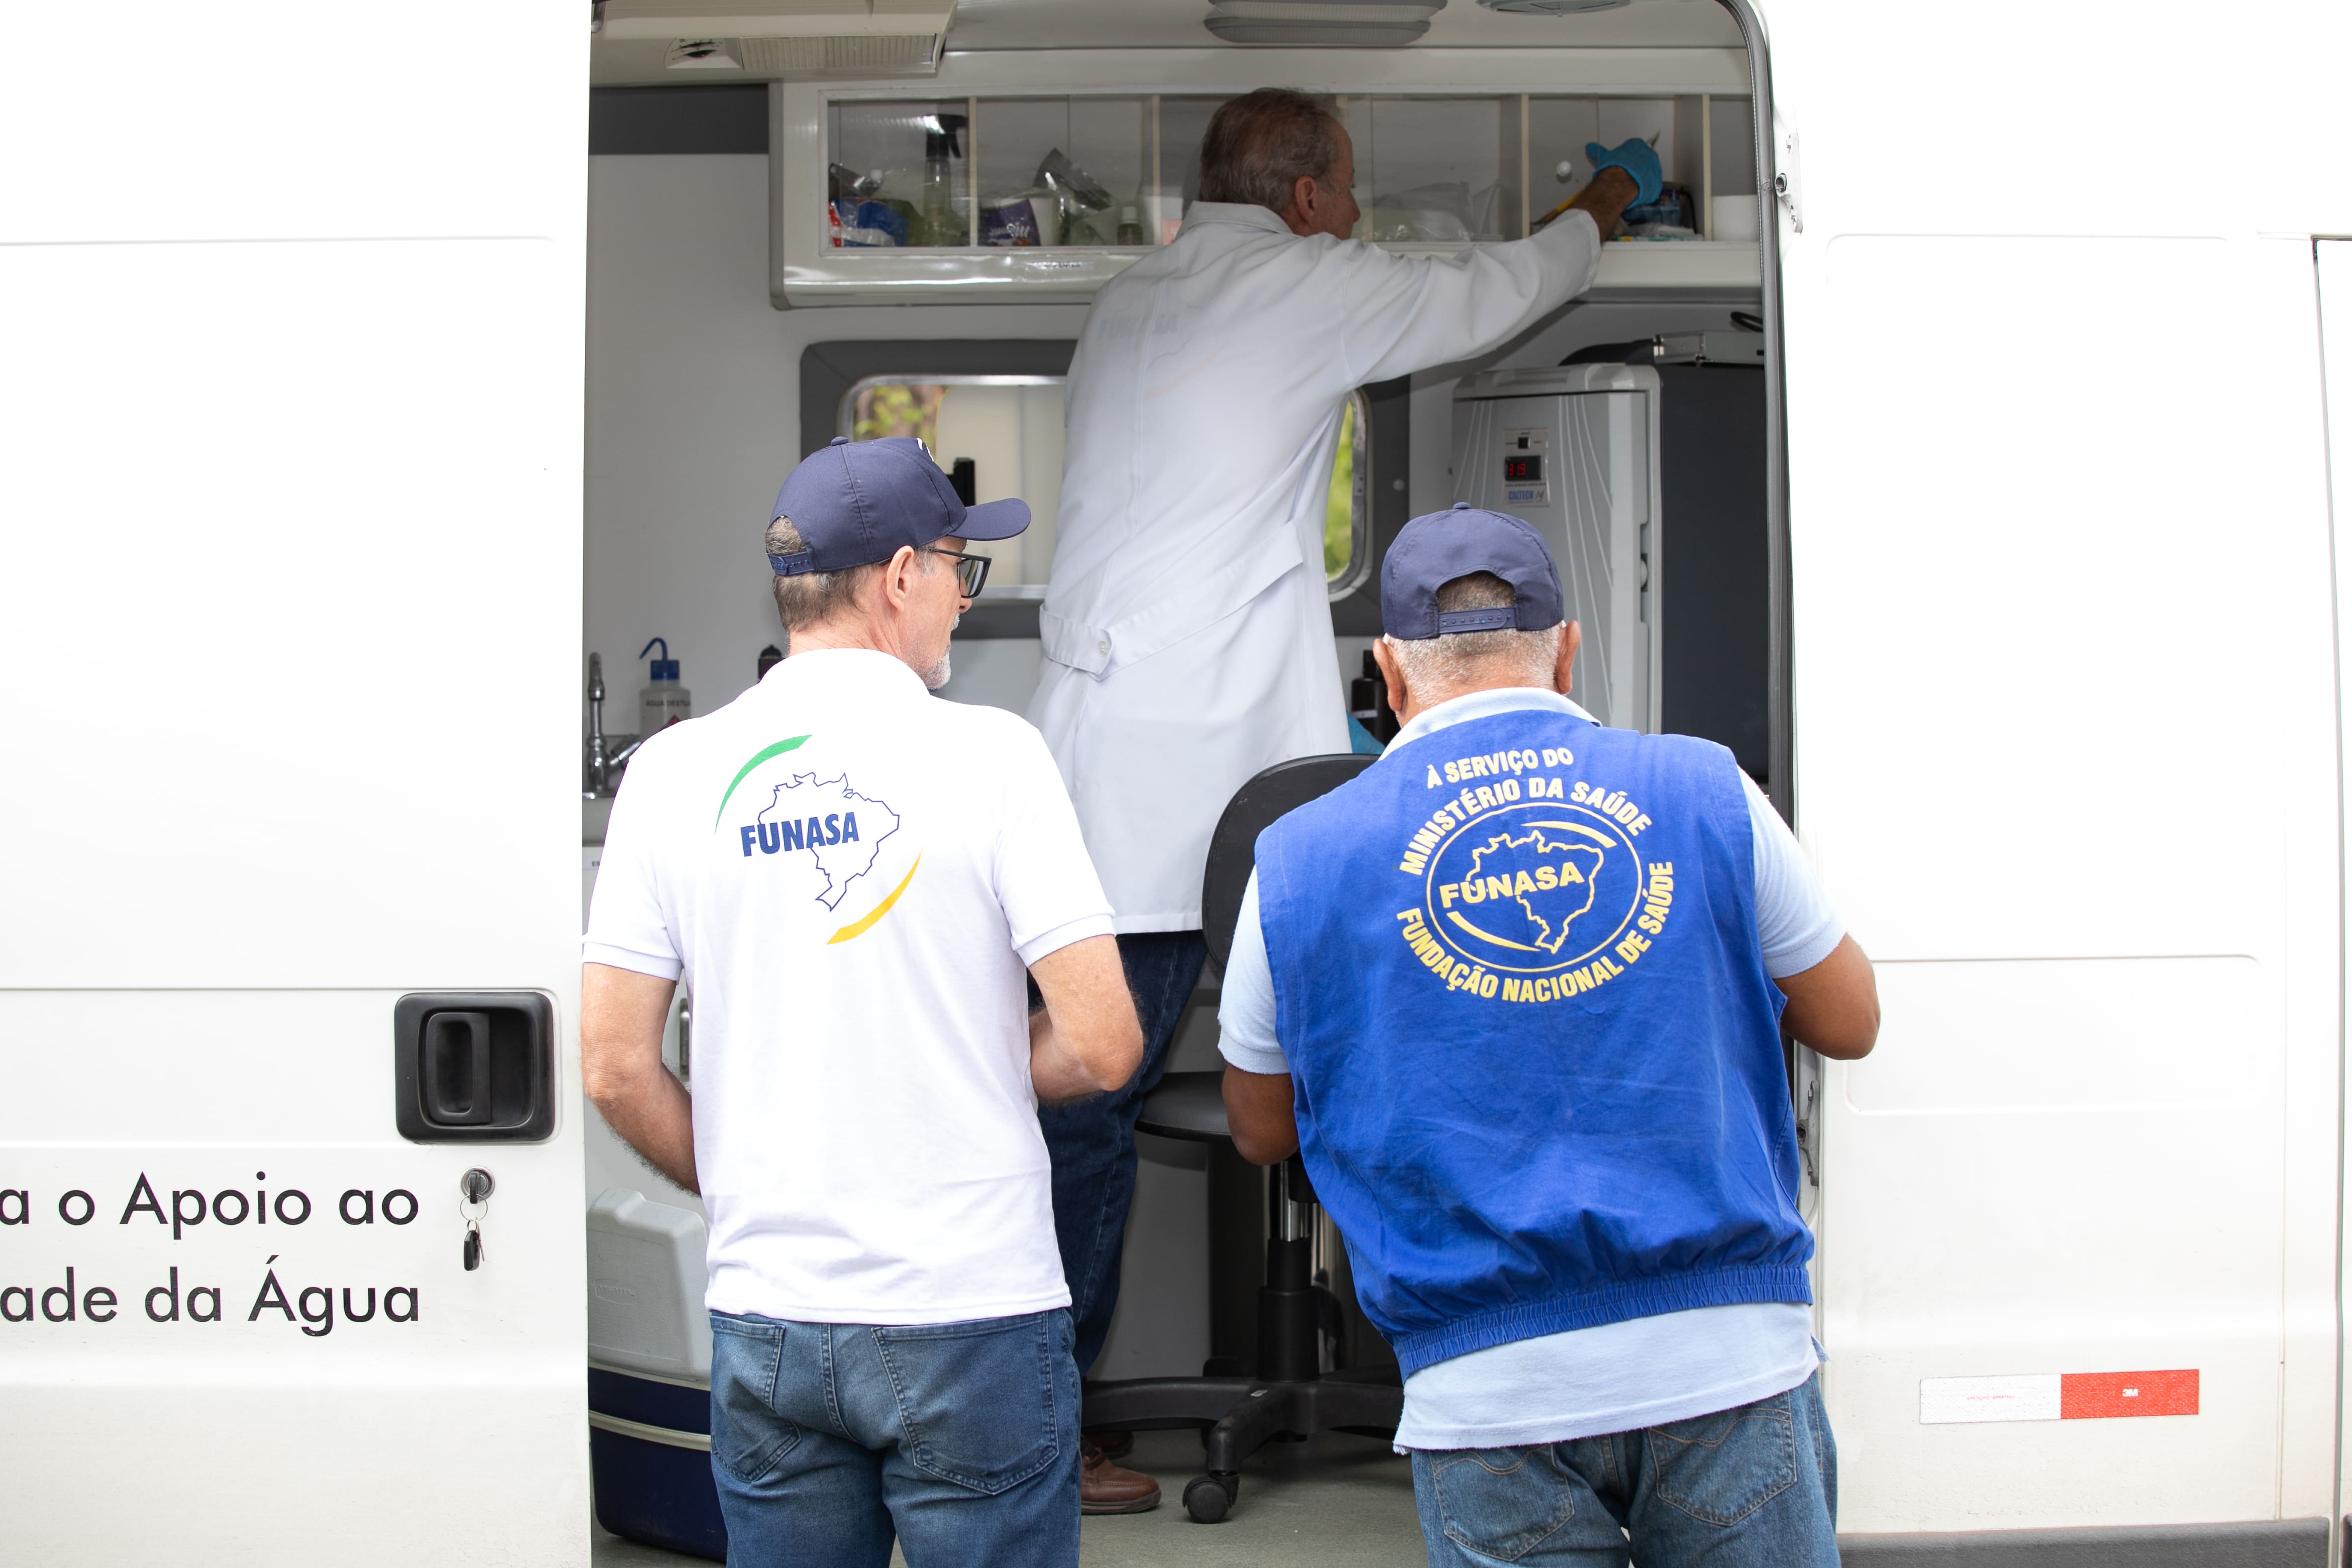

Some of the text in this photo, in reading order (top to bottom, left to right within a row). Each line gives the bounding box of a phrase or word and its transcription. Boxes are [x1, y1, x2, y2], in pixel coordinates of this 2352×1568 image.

[1427, 747, 1574, 789] À SERVIÇO DO
[740, 812, 859, 857] FUNASA
[1399, 777, 1652, 876] MINISTÉRIO DA SAÚDE
[1439, 861, 1585, 909] FUNASA
[1397, 861, 1674, 1003] FUNDAÇÃO NACIONAL DE SAÚDE
[0, 1171, 419, 1240] a o Apoio ao
[0, 1255, 419, 1337] ade da Água
[2122, 1388, 2138, 1397] 3M
